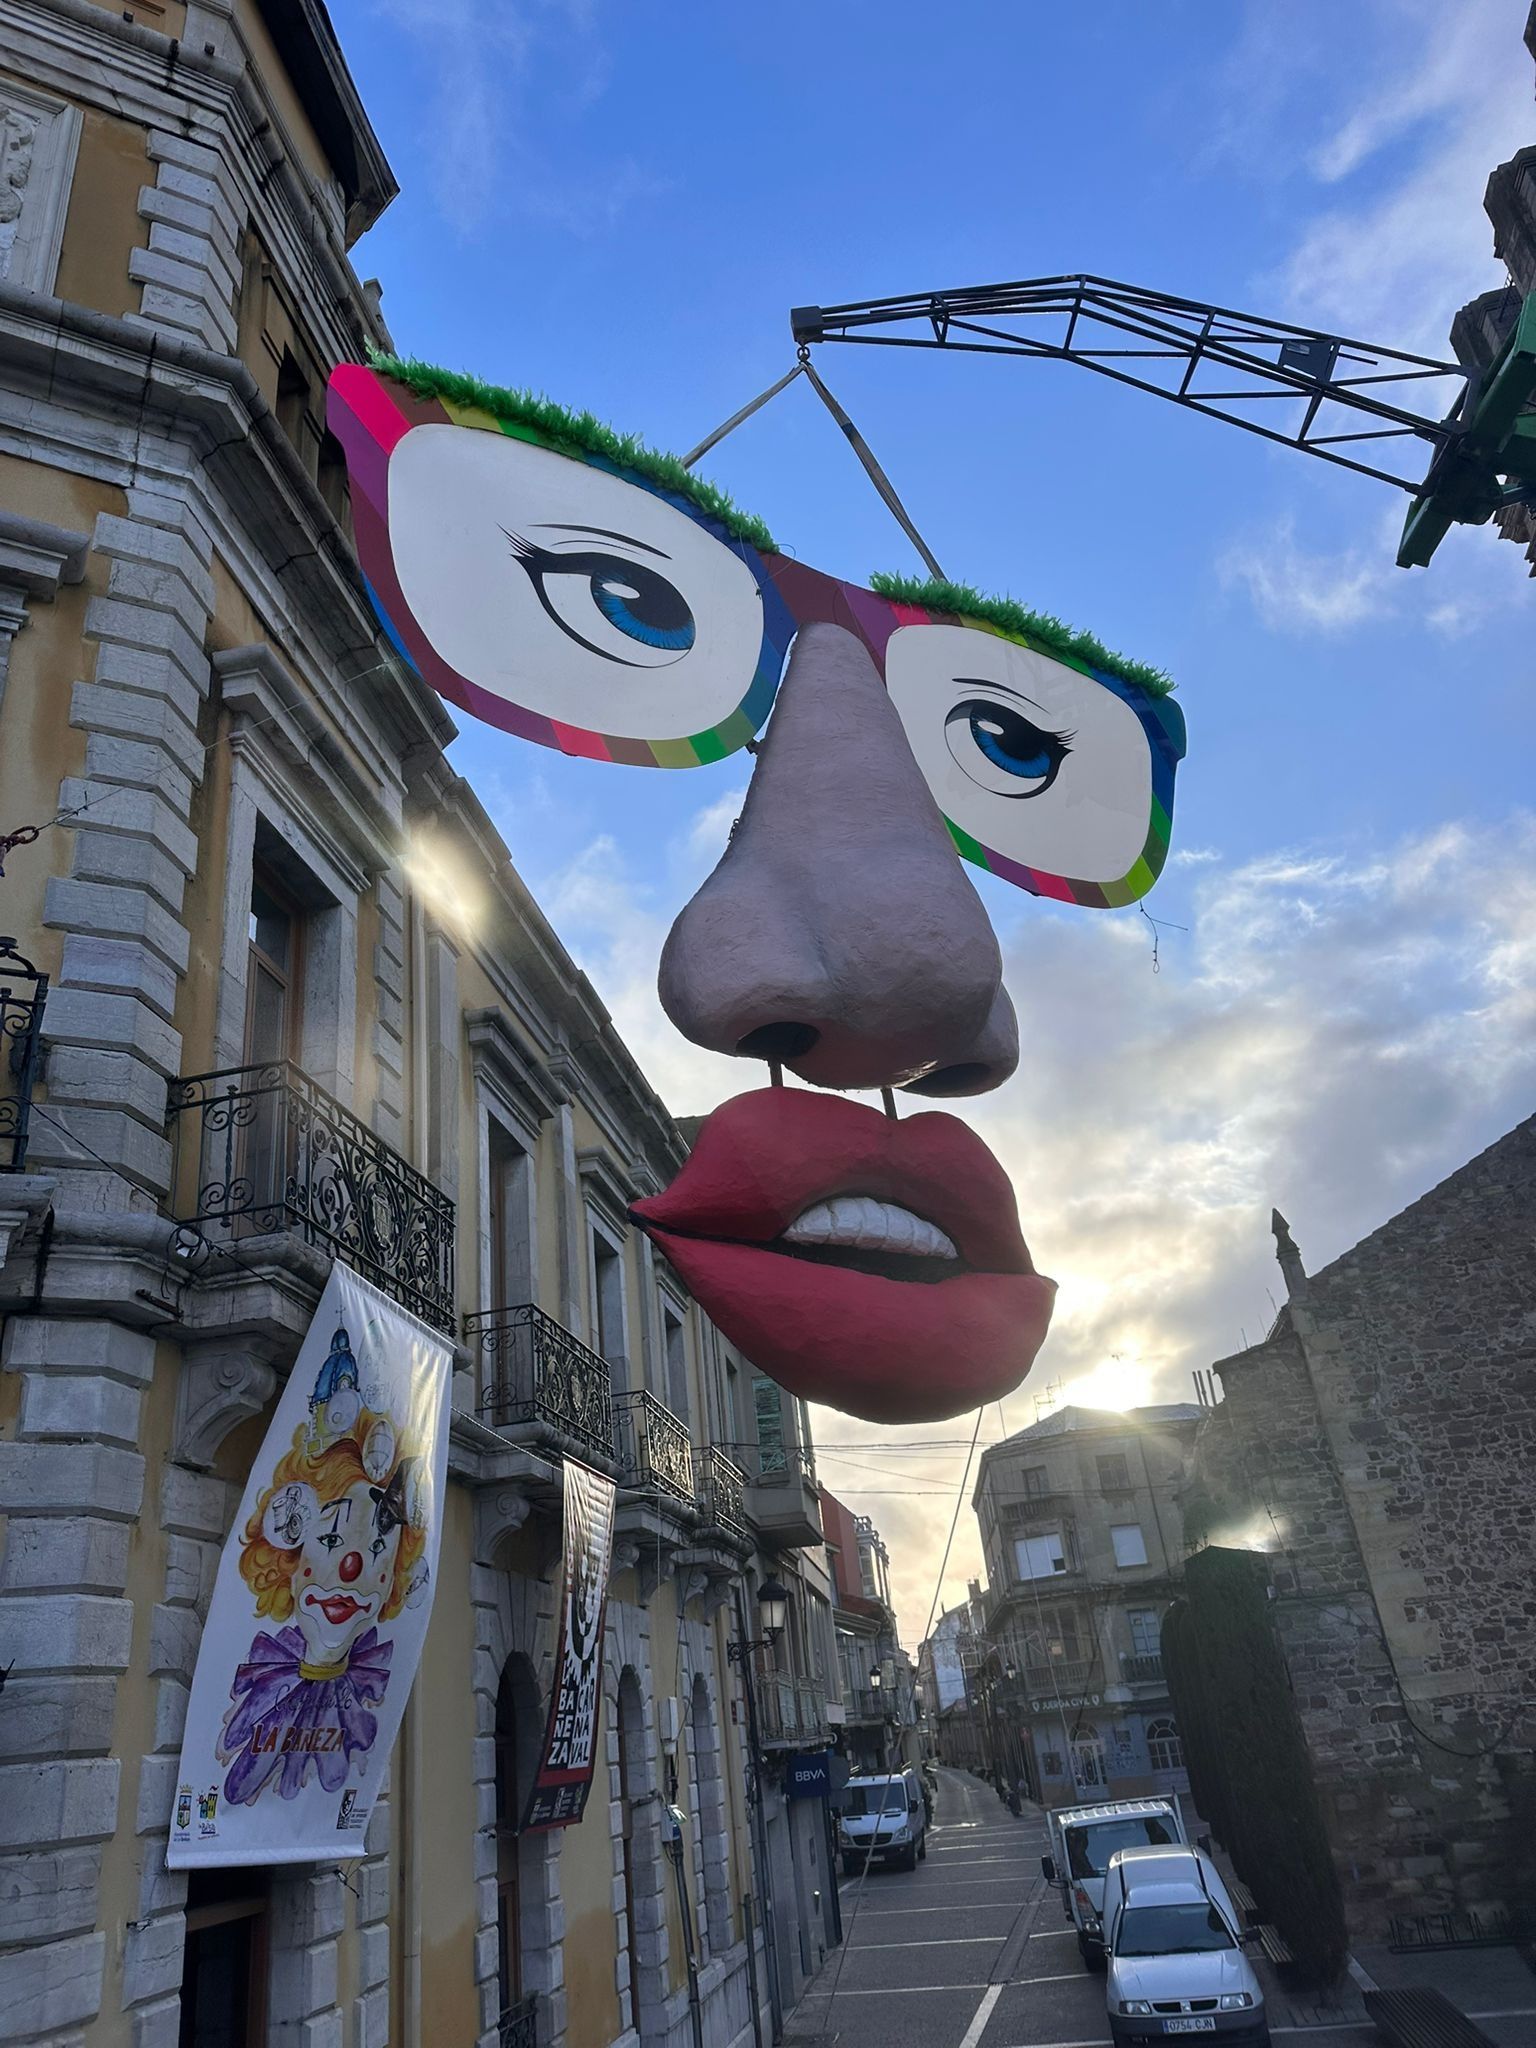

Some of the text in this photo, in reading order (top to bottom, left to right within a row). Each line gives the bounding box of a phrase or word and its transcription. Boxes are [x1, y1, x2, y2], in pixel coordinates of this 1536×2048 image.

[558, 1688, 575, 1711] BA
[573, 1714, 590, 1738] NA
[251, 1724, 279, 1753] LA
[547, 1741, 568, 1765] ZA
[570, 1740, 590, 1765] VAL
[795, 1769, 826, 1782] BBVA
